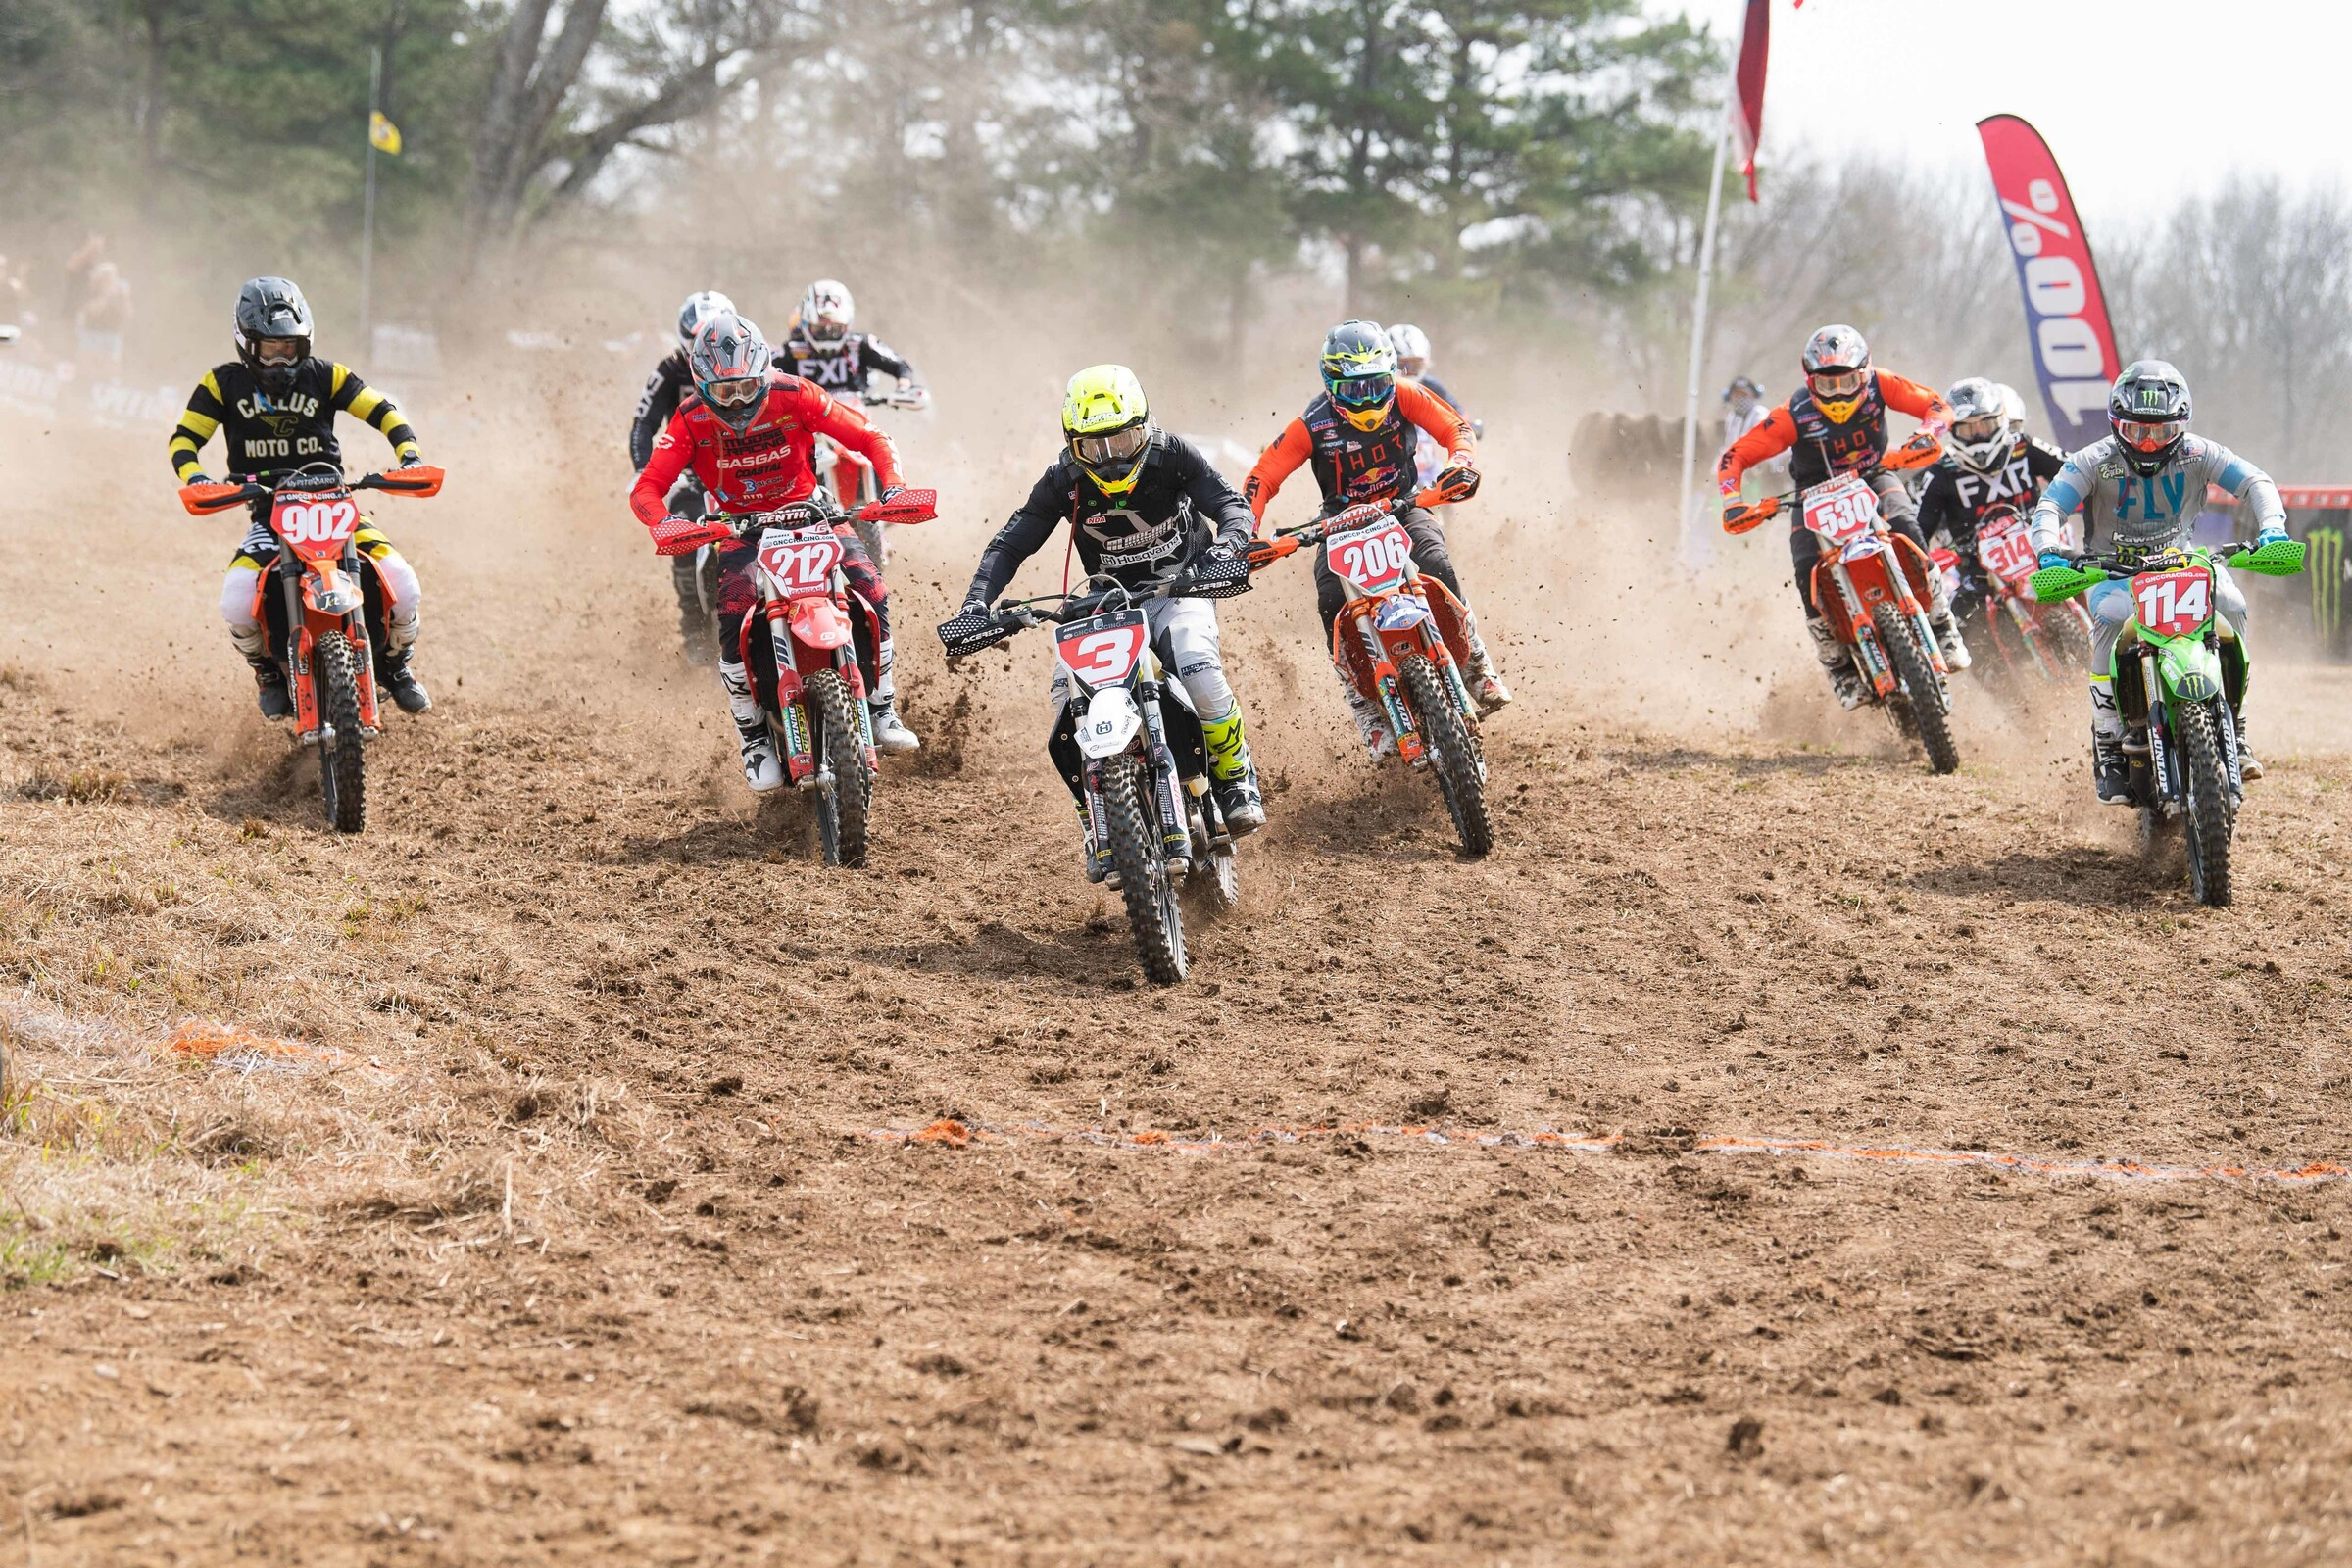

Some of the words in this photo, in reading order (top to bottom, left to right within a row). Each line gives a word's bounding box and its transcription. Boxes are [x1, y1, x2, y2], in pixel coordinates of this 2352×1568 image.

[2001, 178, 2115, 426] 100%
[236, 392, 319, 419] CALLUS
[245, 439, 290, 458] MOTO
[296, 436, 323, 455] CO.
[716, 445, 792, 469] GASGAS
[1816, 491, 1875, 538] 530
[2117, 472, 2185, 520] FLY
[281, 502, 356, 544] 902
[771, 543, 833, 586] 212
[1117, 536, 1181, 565] Husqvarna
[1344, 531, 1408, 586] 206
[1987, 533, 2034, 573] 314
[2145, 571, 2208, 584] GNCCRACING.COM
[2138, 580, 2208, 628] 114
[1074, 628, 1134, 685] 3
[857, 699, 869, 746] DUNLOP
[1386, 677, 1413, 732] DNLOP
[789, 707, 803, 754] DUNLOP
[2222, 718, 2239, 786] DUNLOP
[2152, 726, 2169, 793] DUNLOP
